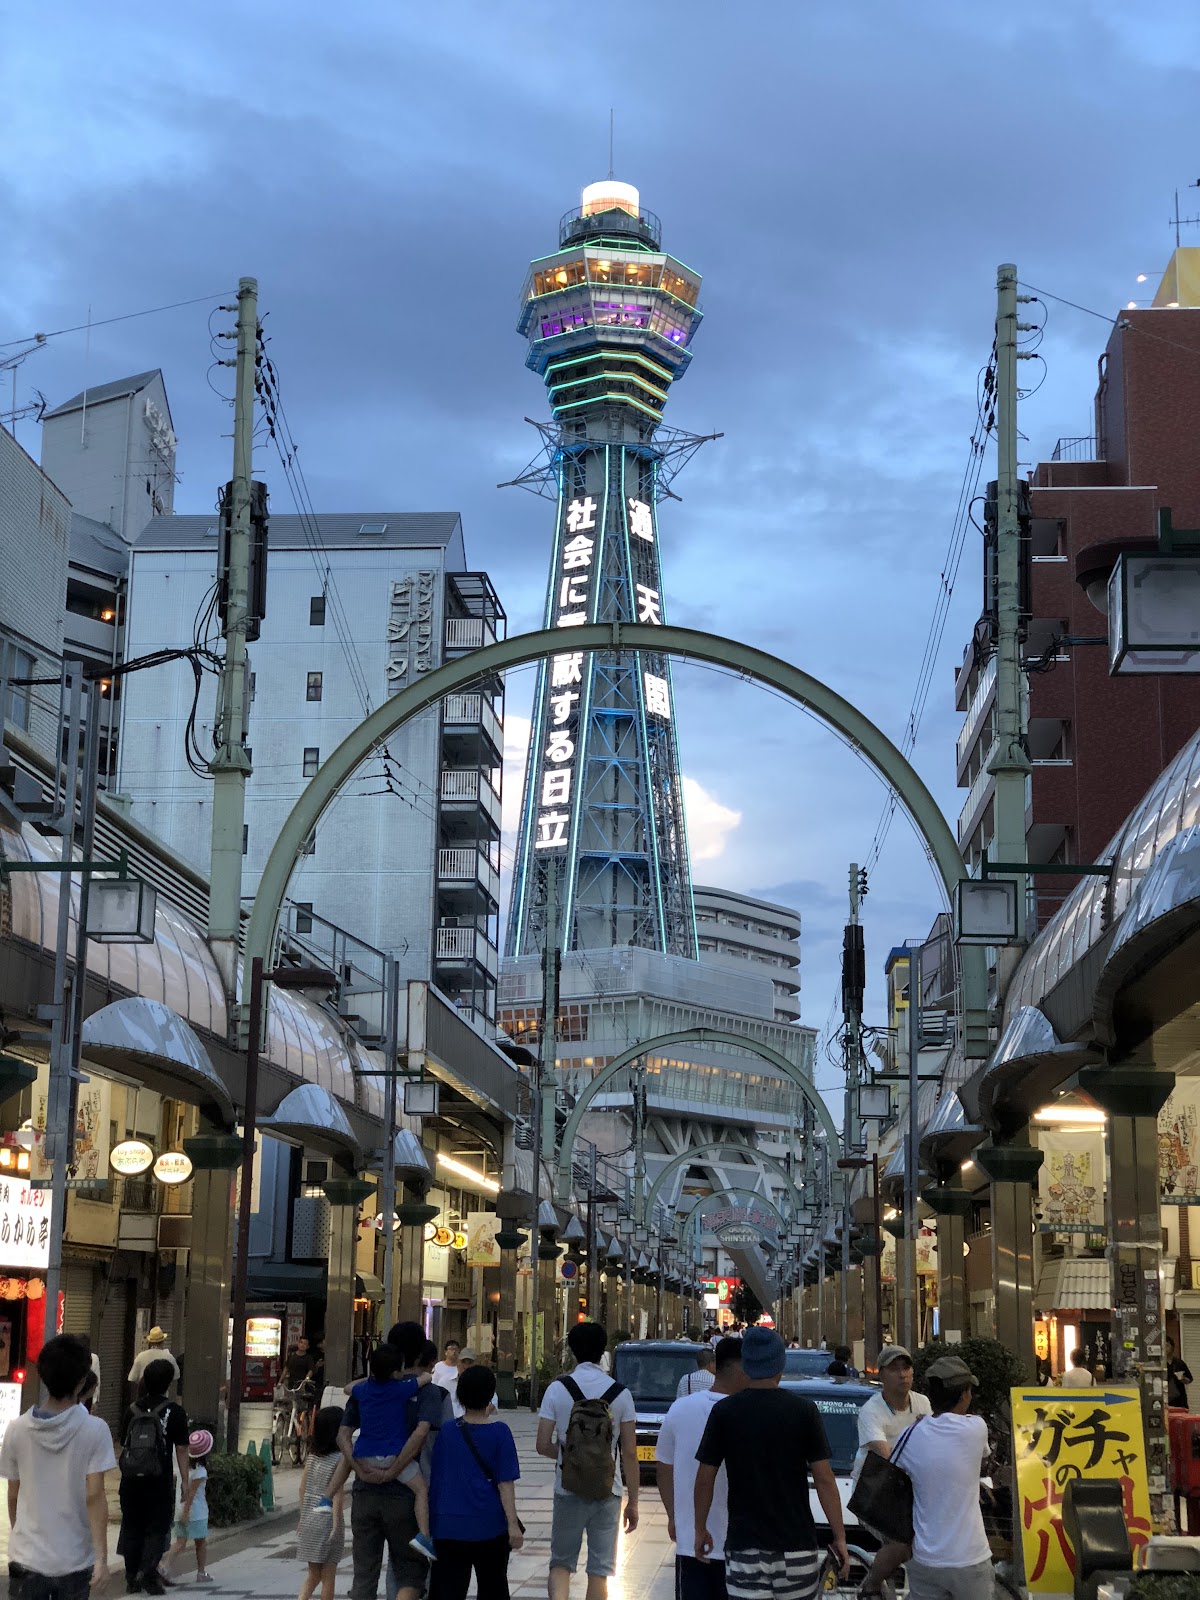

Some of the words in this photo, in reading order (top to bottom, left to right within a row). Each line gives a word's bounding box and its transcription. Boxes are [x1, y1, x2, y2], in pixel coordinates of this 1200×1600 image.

[629, 497, 671, 719] 通天閣
[20, 1187, 45, 1208] ホルモン
[720, 1235, 761, 1243] SHINSEKAI
[1016, 1407, 1138, 1475] ガチャ
[1056, 1464, 1082, 1486] の
